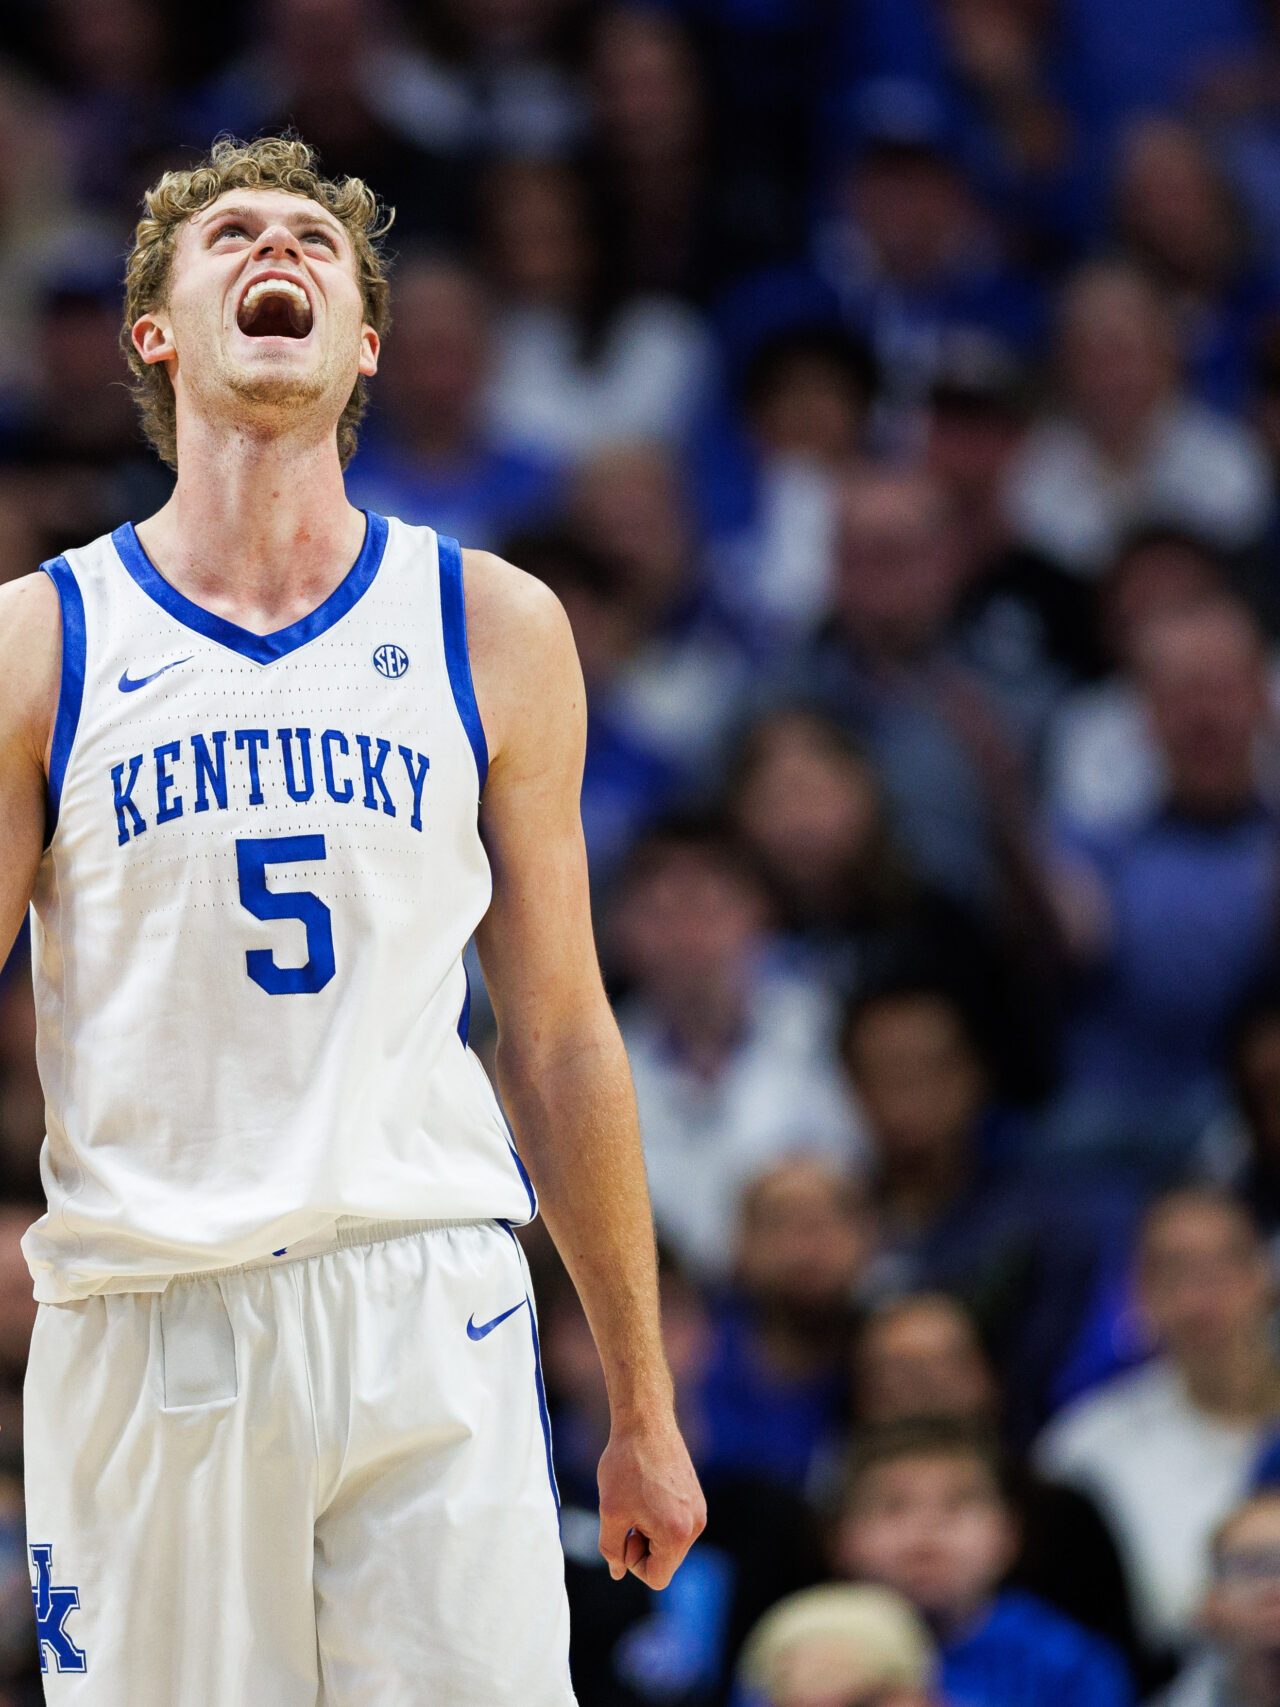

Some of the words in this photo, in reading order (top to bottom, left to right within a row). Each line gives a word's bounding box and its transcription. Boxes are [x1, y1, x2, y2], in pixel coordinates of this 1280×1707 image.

[374, 645, 408, 678] SEC
[111, 727, 430, 847] KENTUCKY
[236, 834, 336, 995] 5
